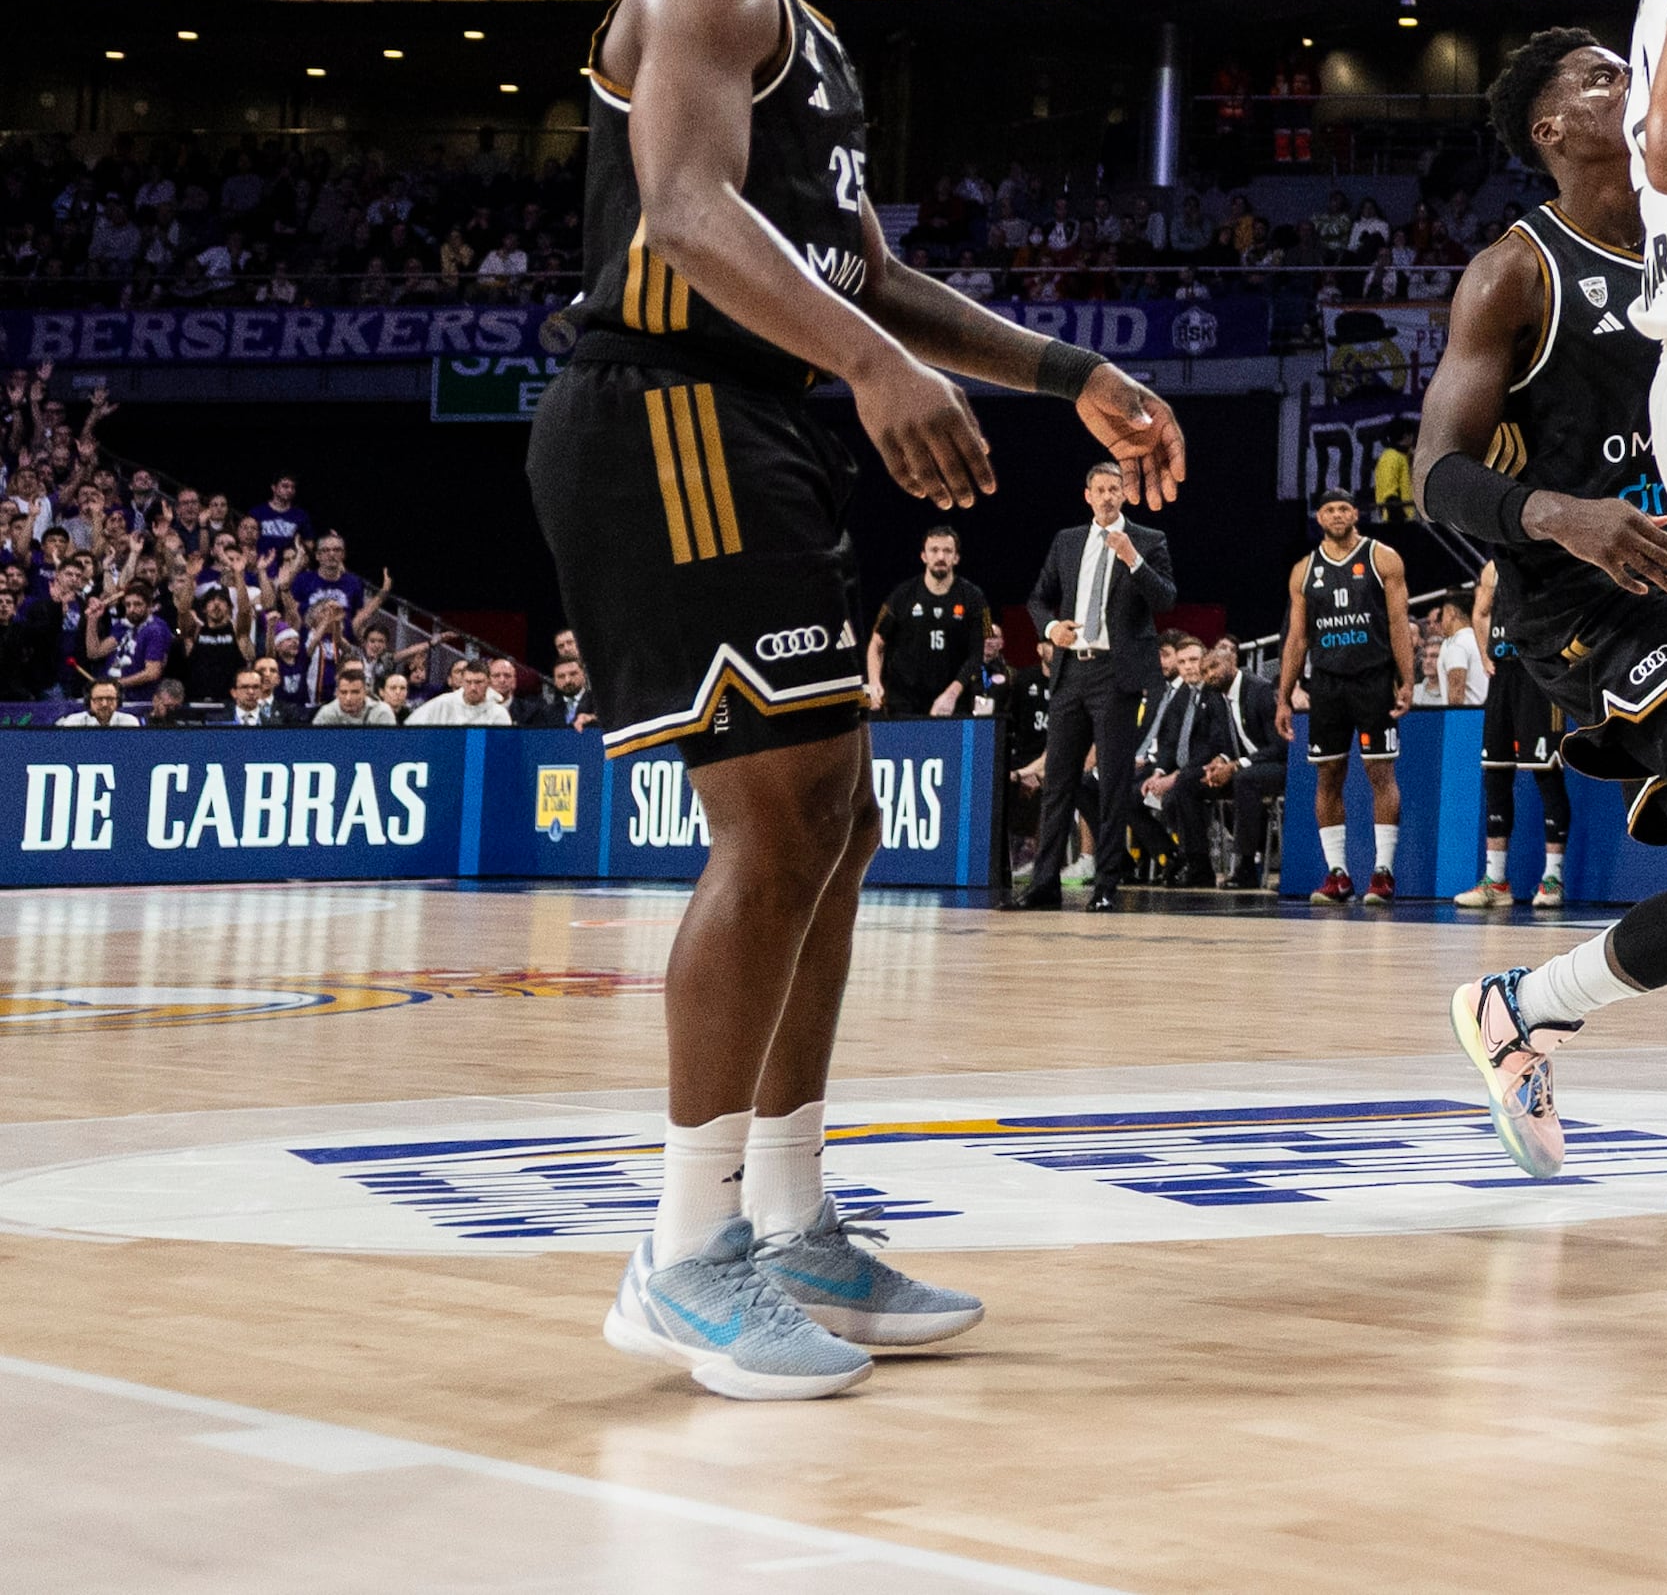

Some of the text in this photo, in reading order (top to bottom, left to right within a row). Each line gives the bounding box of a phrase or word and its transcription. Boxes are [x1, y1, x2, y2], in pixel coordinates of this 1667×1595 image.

[829, 146, 867, 217] 25
[27, 310, 528, 361] BERSERKERS
[1333, 588, 1349, 609] 10
[1316, 612, 1372, 631] OMNIYAT
[1320, 628, 1369, 648] dnata
[930, 630, 945, 650] 15
[21, 762, 429, 851] DE CABRAS
[629, 758, 944, 851] SOLA RAS
